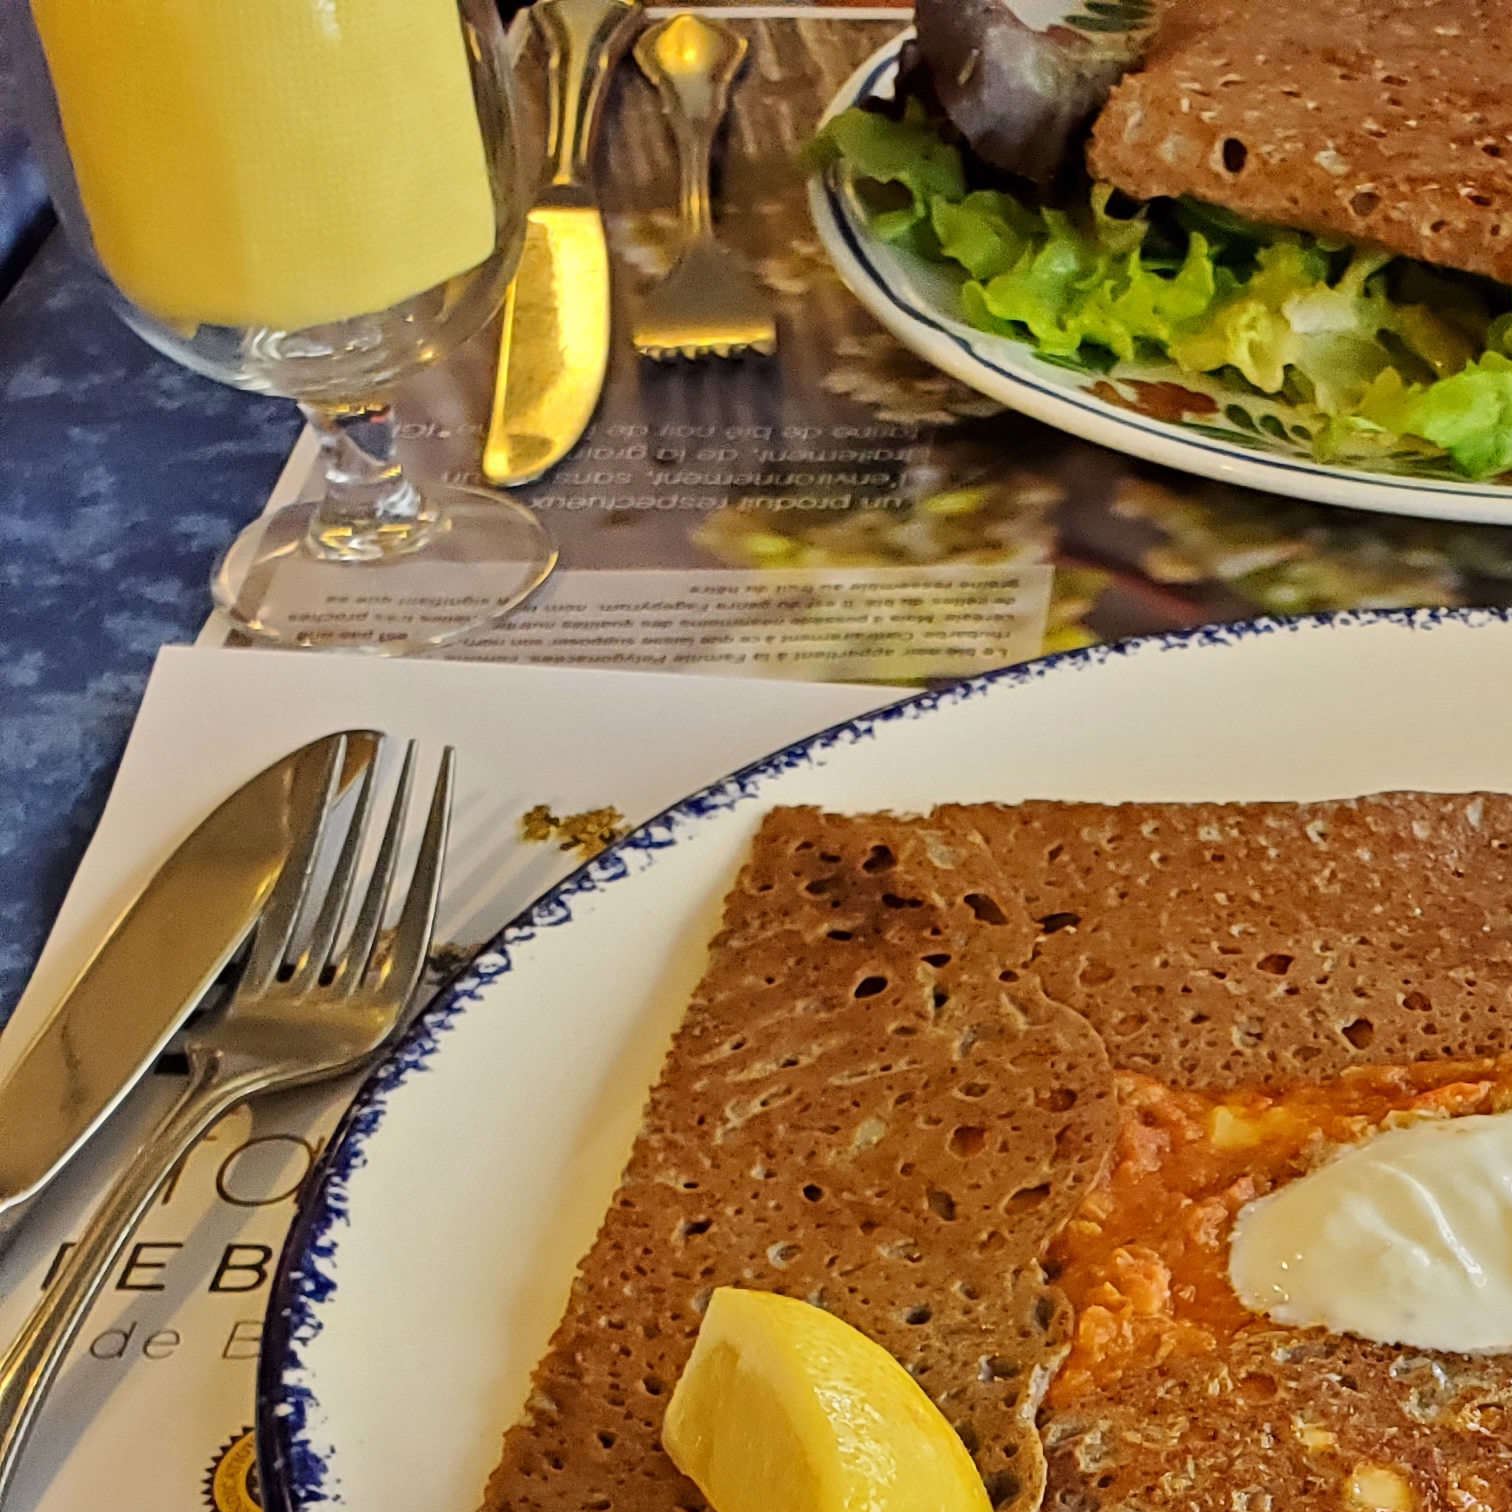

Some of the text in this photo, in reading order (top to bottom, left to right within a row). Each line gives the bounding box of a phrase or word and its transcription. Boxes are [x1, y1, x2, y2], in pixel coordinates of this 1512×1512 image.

[531, 495, 728, 510] respectueux
[735, 494, 851, 512] produit
[207, 1243, 274, 1293] B
[89, 1321, 181, 1361] de
